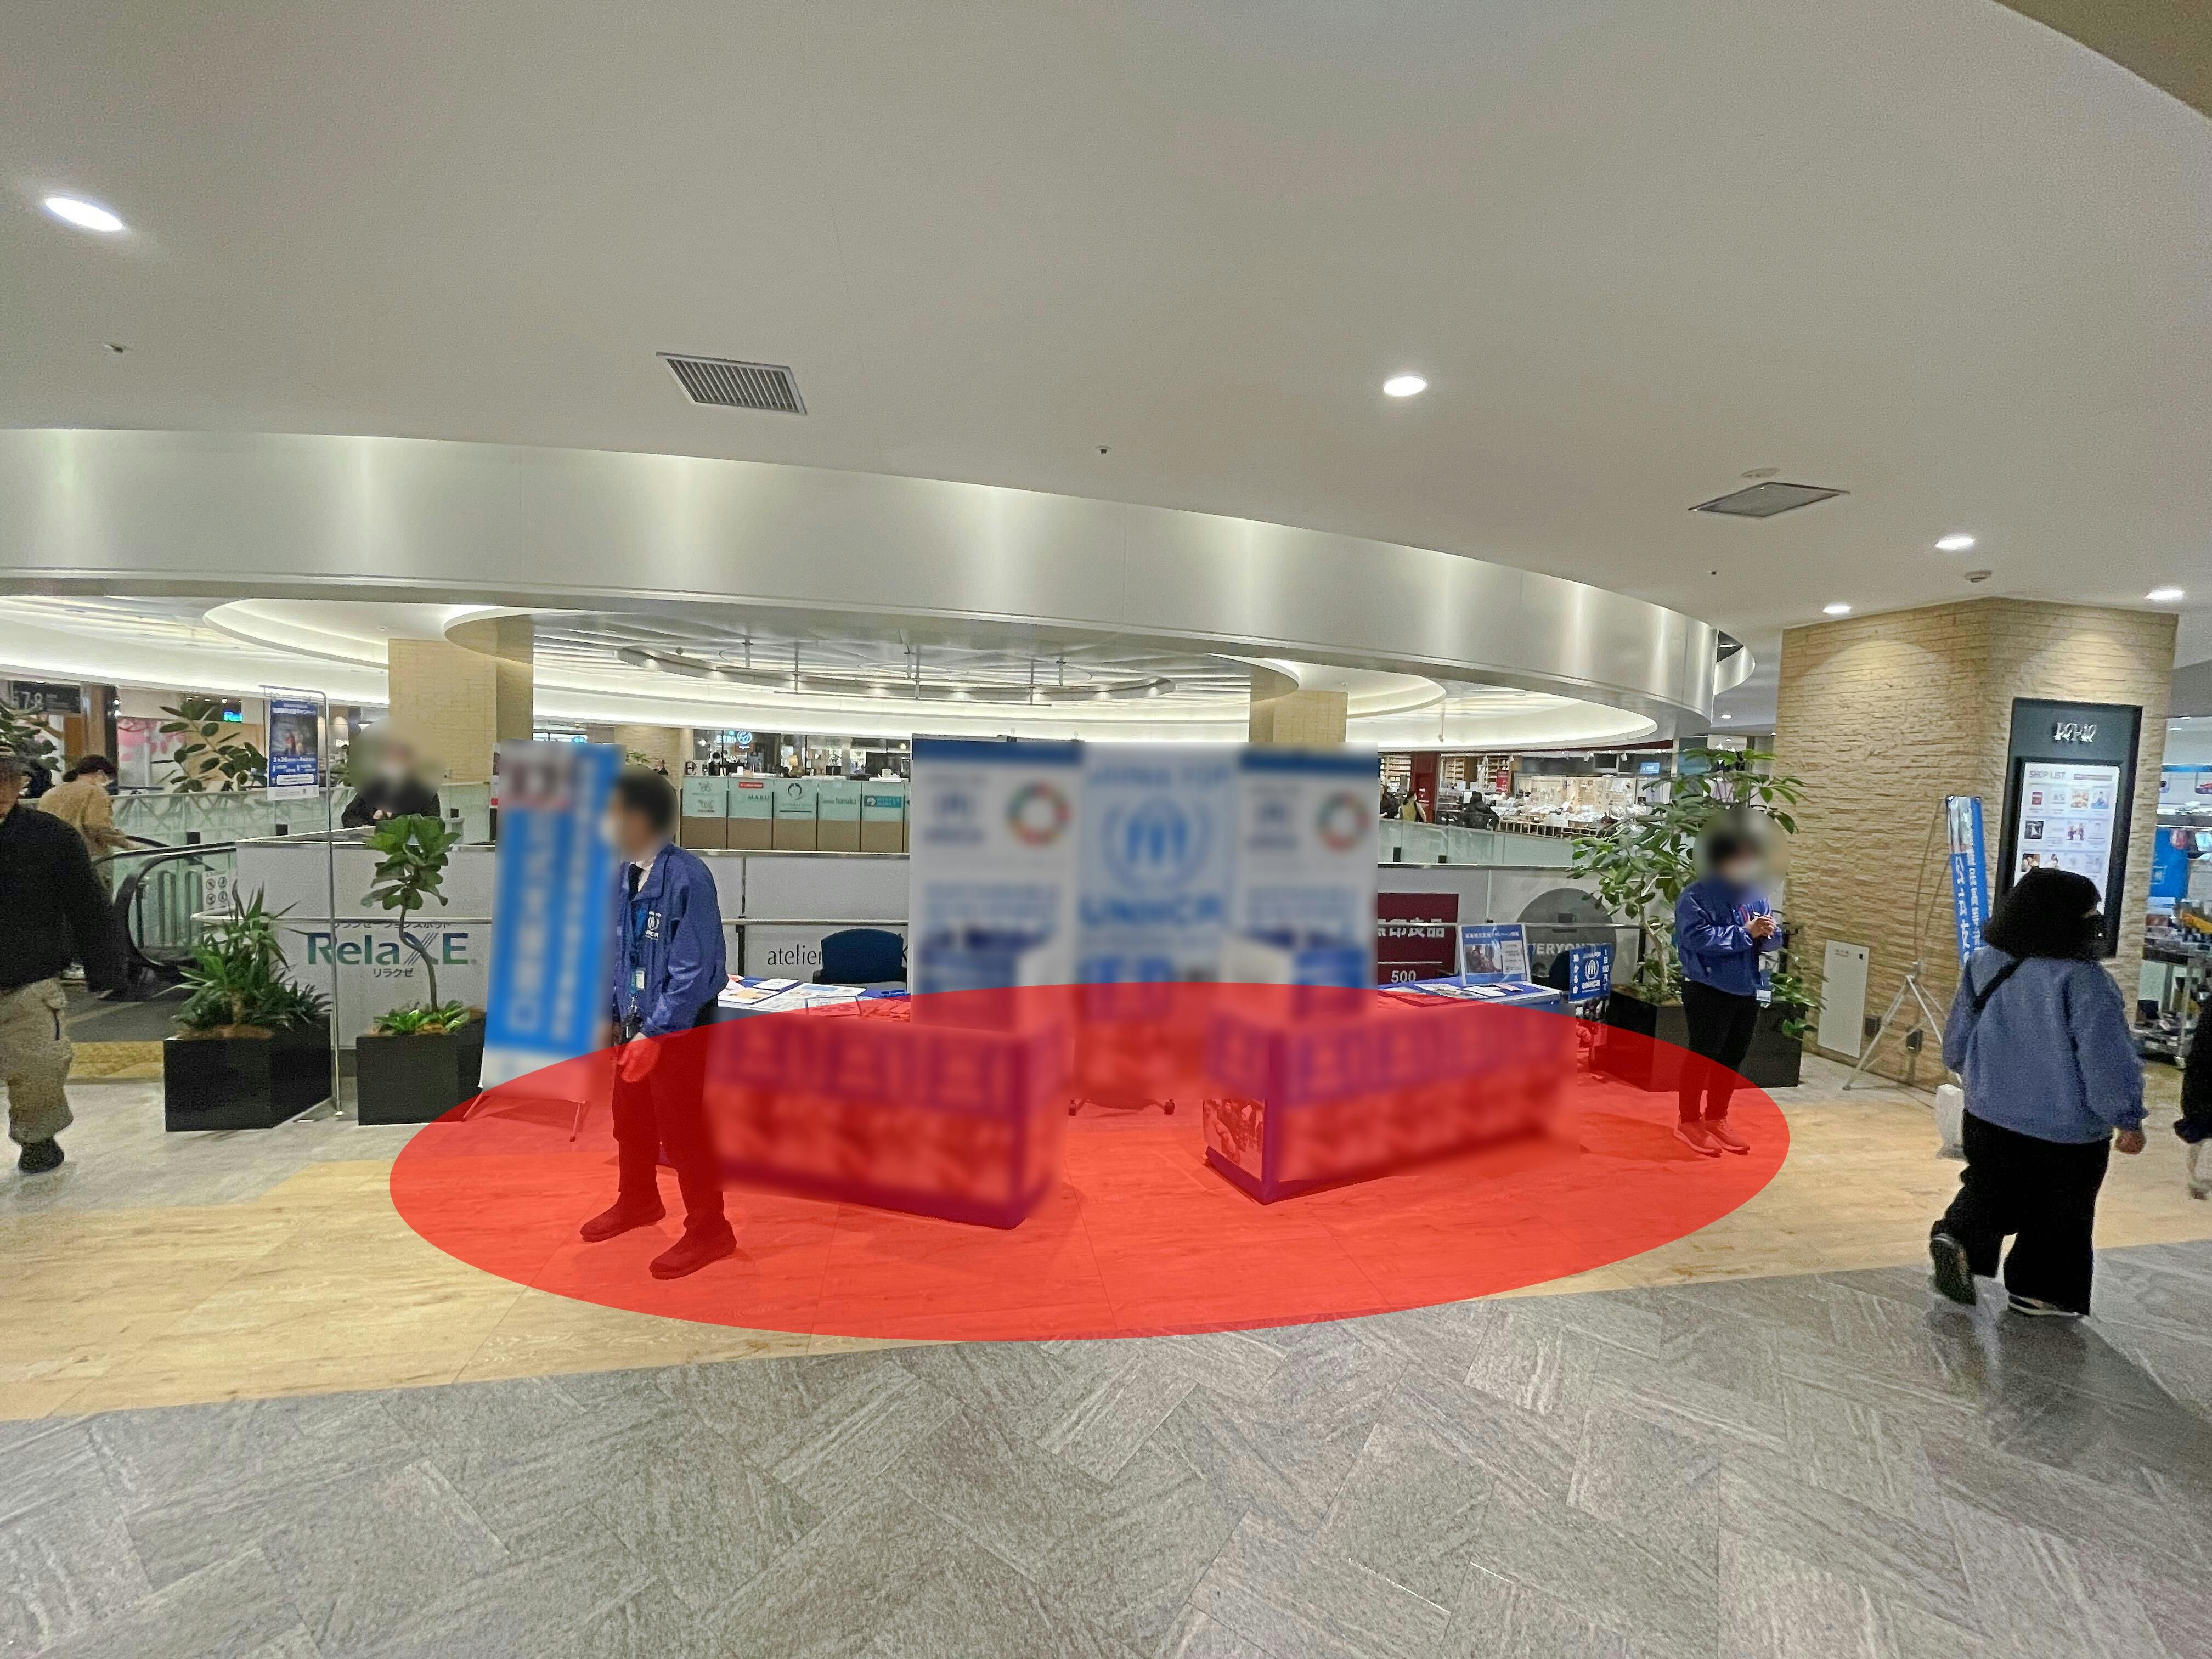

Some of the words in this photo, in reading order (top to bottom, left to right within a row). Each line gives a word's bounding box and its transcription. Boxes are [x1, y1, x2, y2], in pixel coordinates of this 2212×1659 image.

[2029, 770, 2048, 779] SHOP
[2050, 771, 2066, 780] LIST
[373, 968, 414, 978] リラクゼ
[1391, 970, 1417, 983] 500
